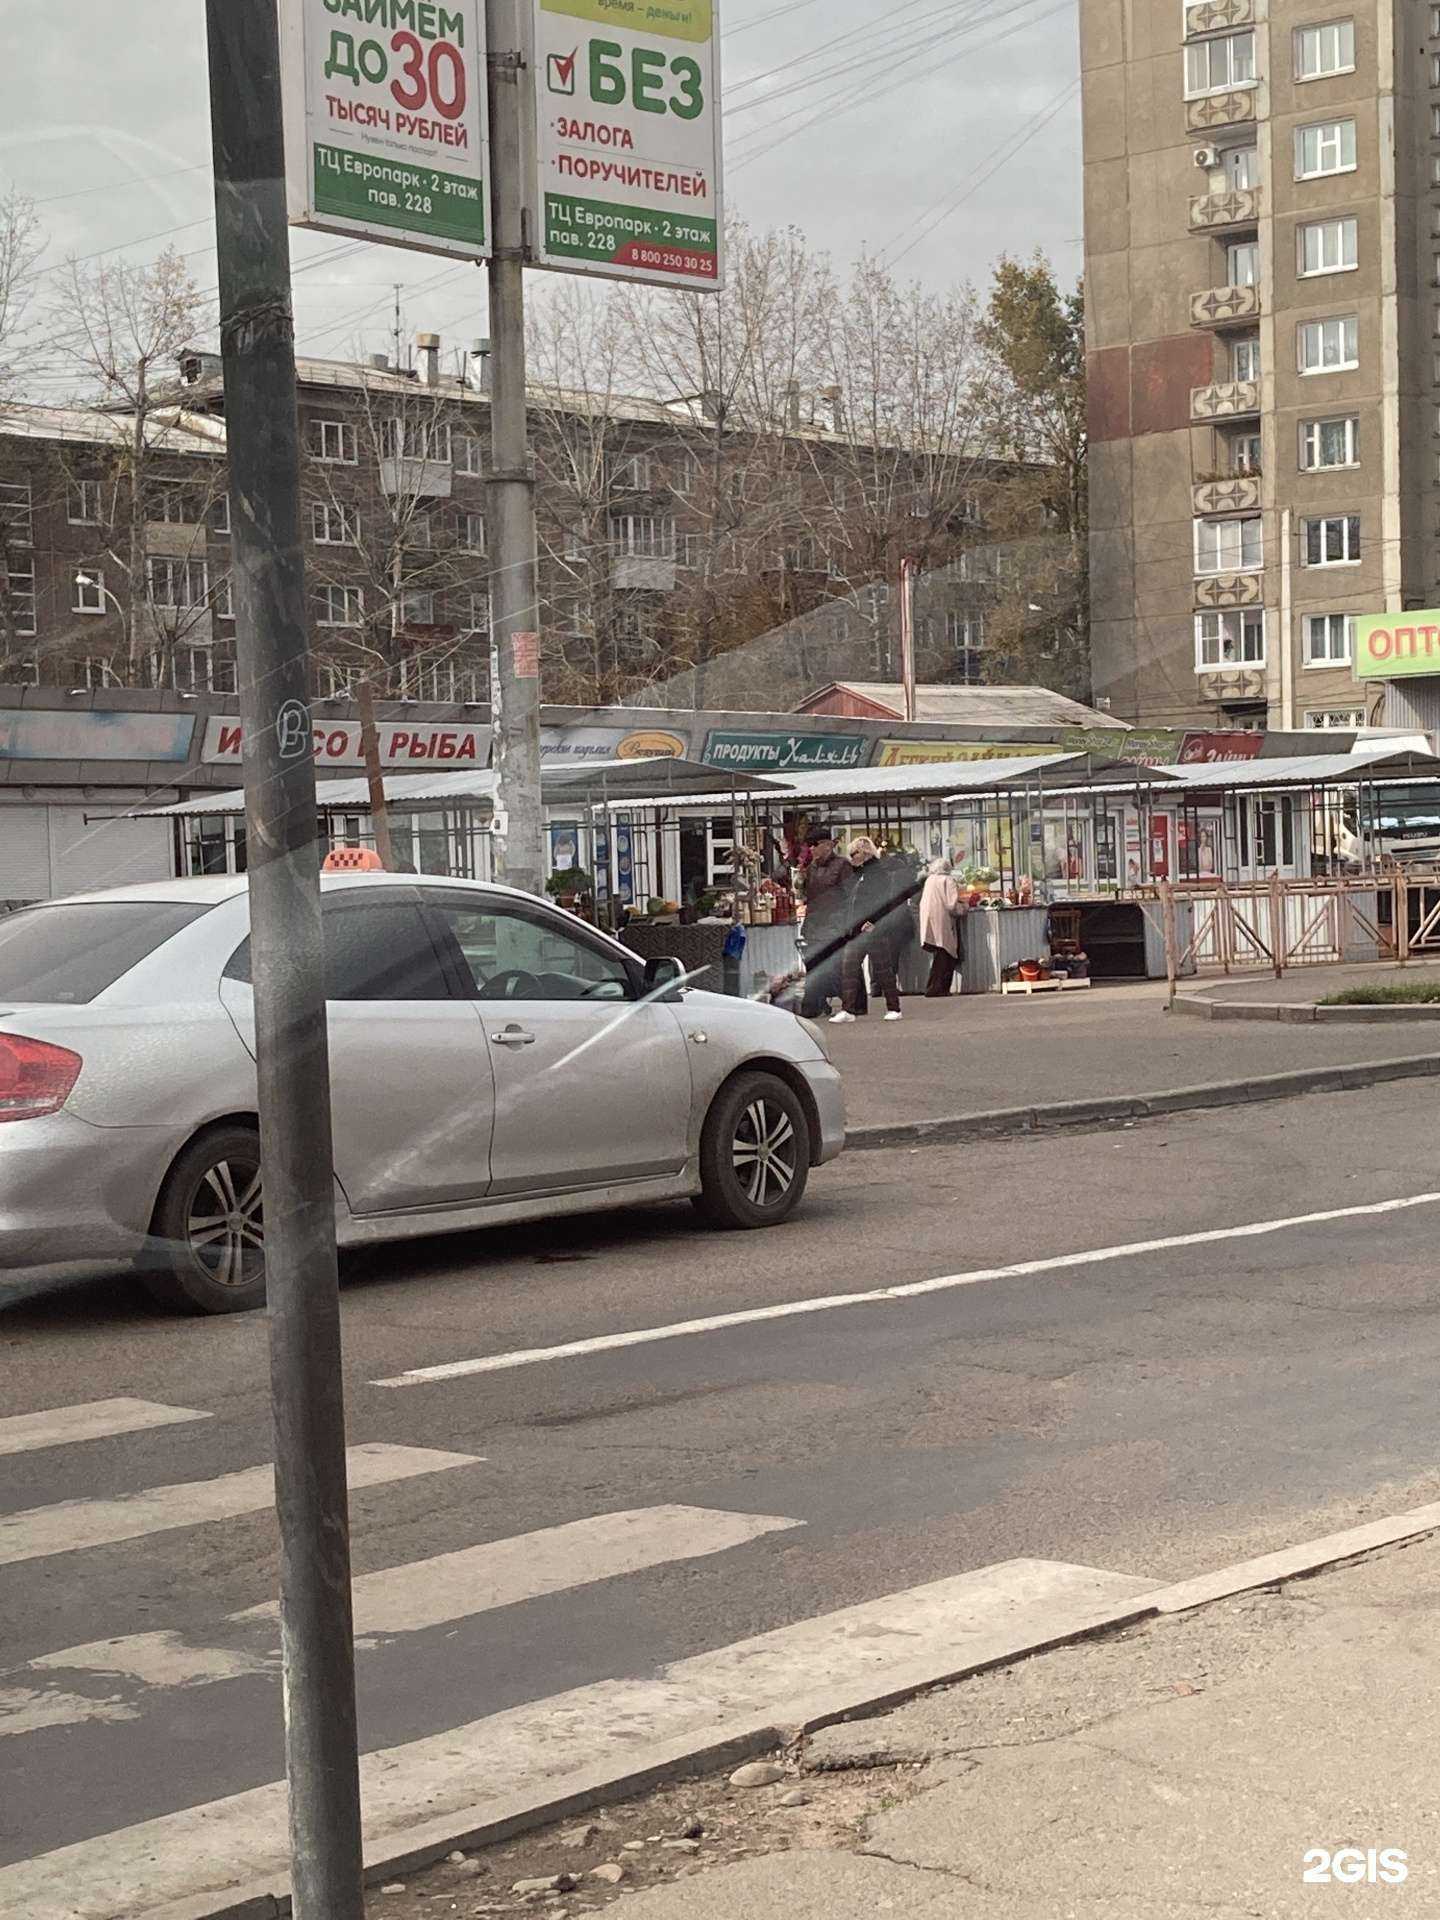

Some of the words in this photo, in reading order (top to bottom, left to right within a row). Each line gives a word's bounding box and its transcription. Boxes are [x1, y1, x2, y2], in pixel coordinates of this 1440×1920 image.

[325, 30, 388, 86] ДО
[390, 31, 466, 120] 30
[589, 39, 704, 119] БЕЗ
[325, 95, 389, 130] ТЫСЯЧ
[395, 112, 467, 148] РУБЛЕЙ
[557, 117, 634, 149] ЗАЛОГА
[318, 148, 340, 175] ТЦ
[344, 154, 420, 188] Европарк
[431, 174, 439, 192] 2
[443, 180, 478, 200] этаж
[558, 154, 706, 198] ПОРУЧИТЕЛЕЙ
[368, 188, 400, 208] пав.
[405, 192, 432, 214] 228
[548, 202, 571, 226] ТЦ
[575, 207, 652, 236] Европарк
[663, 221, 671, 237] 2
[675, 226, 711, 243] этаж
[550, 230, 583, 247] пав.
[587, 232, 616, 251] 228
[631, 248, 638, 260] 8
[641, 250, 660, 264] 800
[663, 255, 682, 267] 250
[684, 257, 697, 269] 30
[700, 259, 712, 272] 25
[1368, 625, 1440, 660] ОПТ
[312, 729, 348, 758] СО
[389, 732, 476, 759] РЫБА
[713, 743, 780, 762] ПРОДУКТЫ
